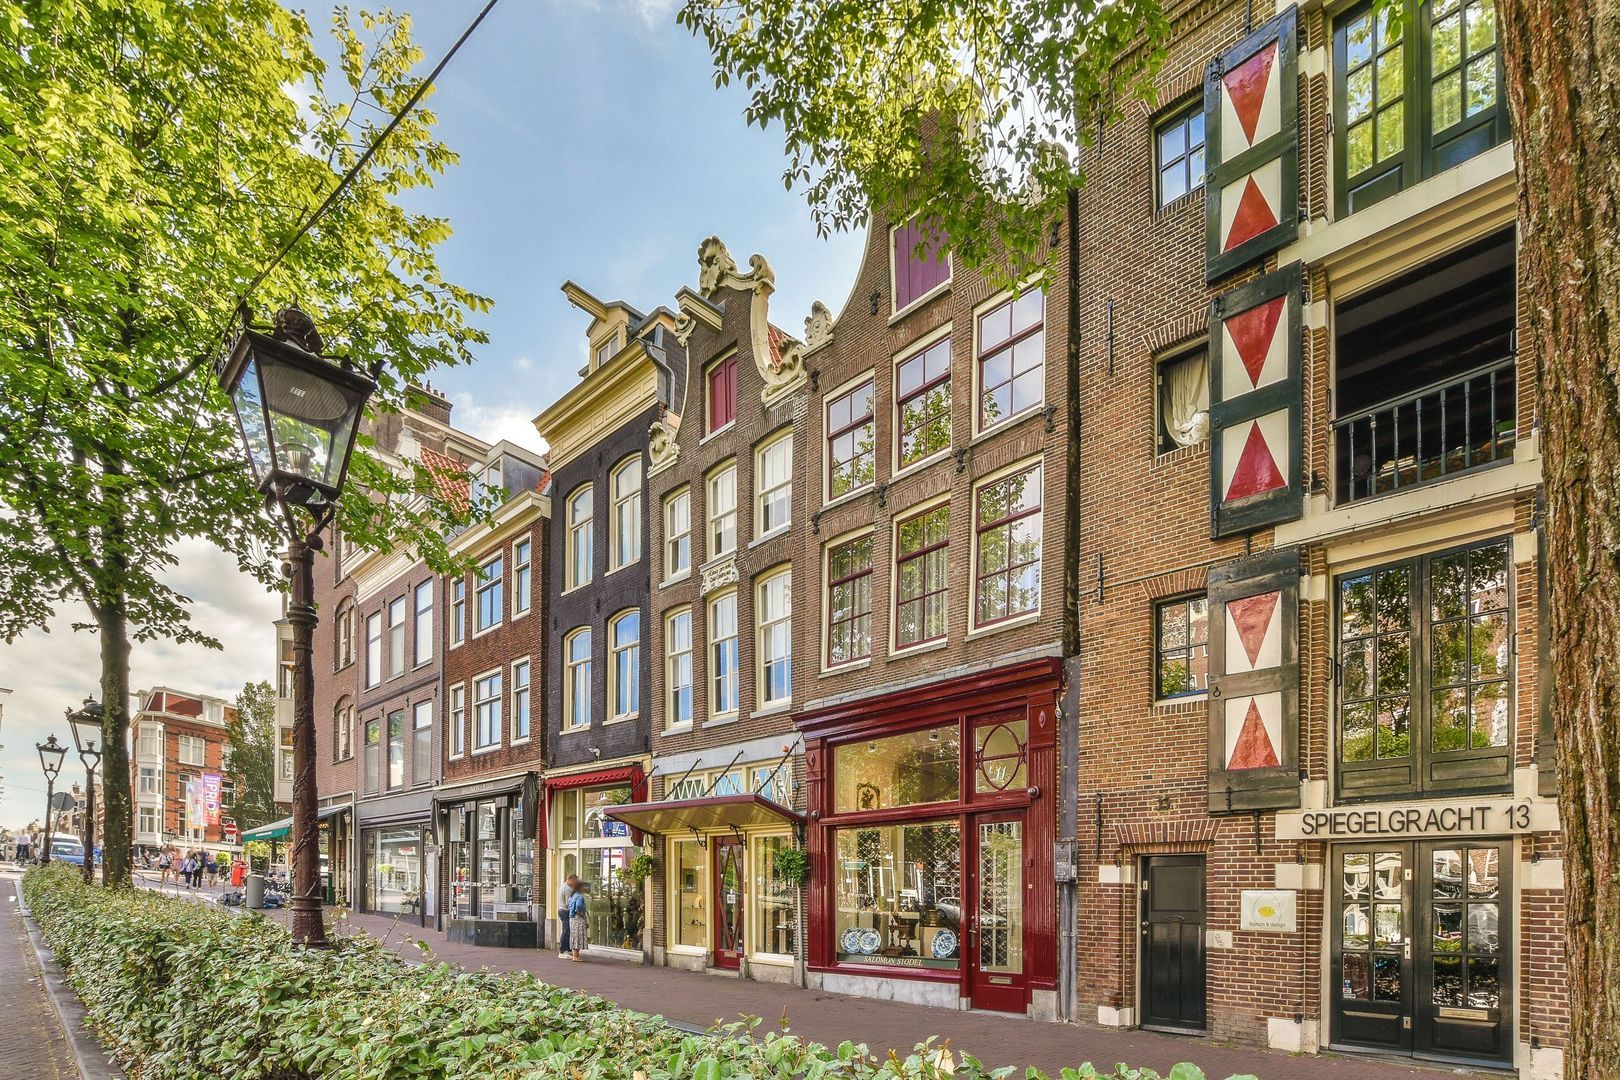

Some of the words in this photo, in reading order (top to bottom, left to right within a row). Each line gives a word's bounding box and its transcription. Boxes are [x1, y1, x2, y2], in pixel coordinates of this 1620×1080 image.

[205, 783, 218, 817] PRIDE
[1301, 806, 1492, 835] SPIEGELGRACHT
[1504, 804, 1530, 829] 13
[863, 956, 895, 965] SALOMON
[897, 958, 923, 966] STODEL
